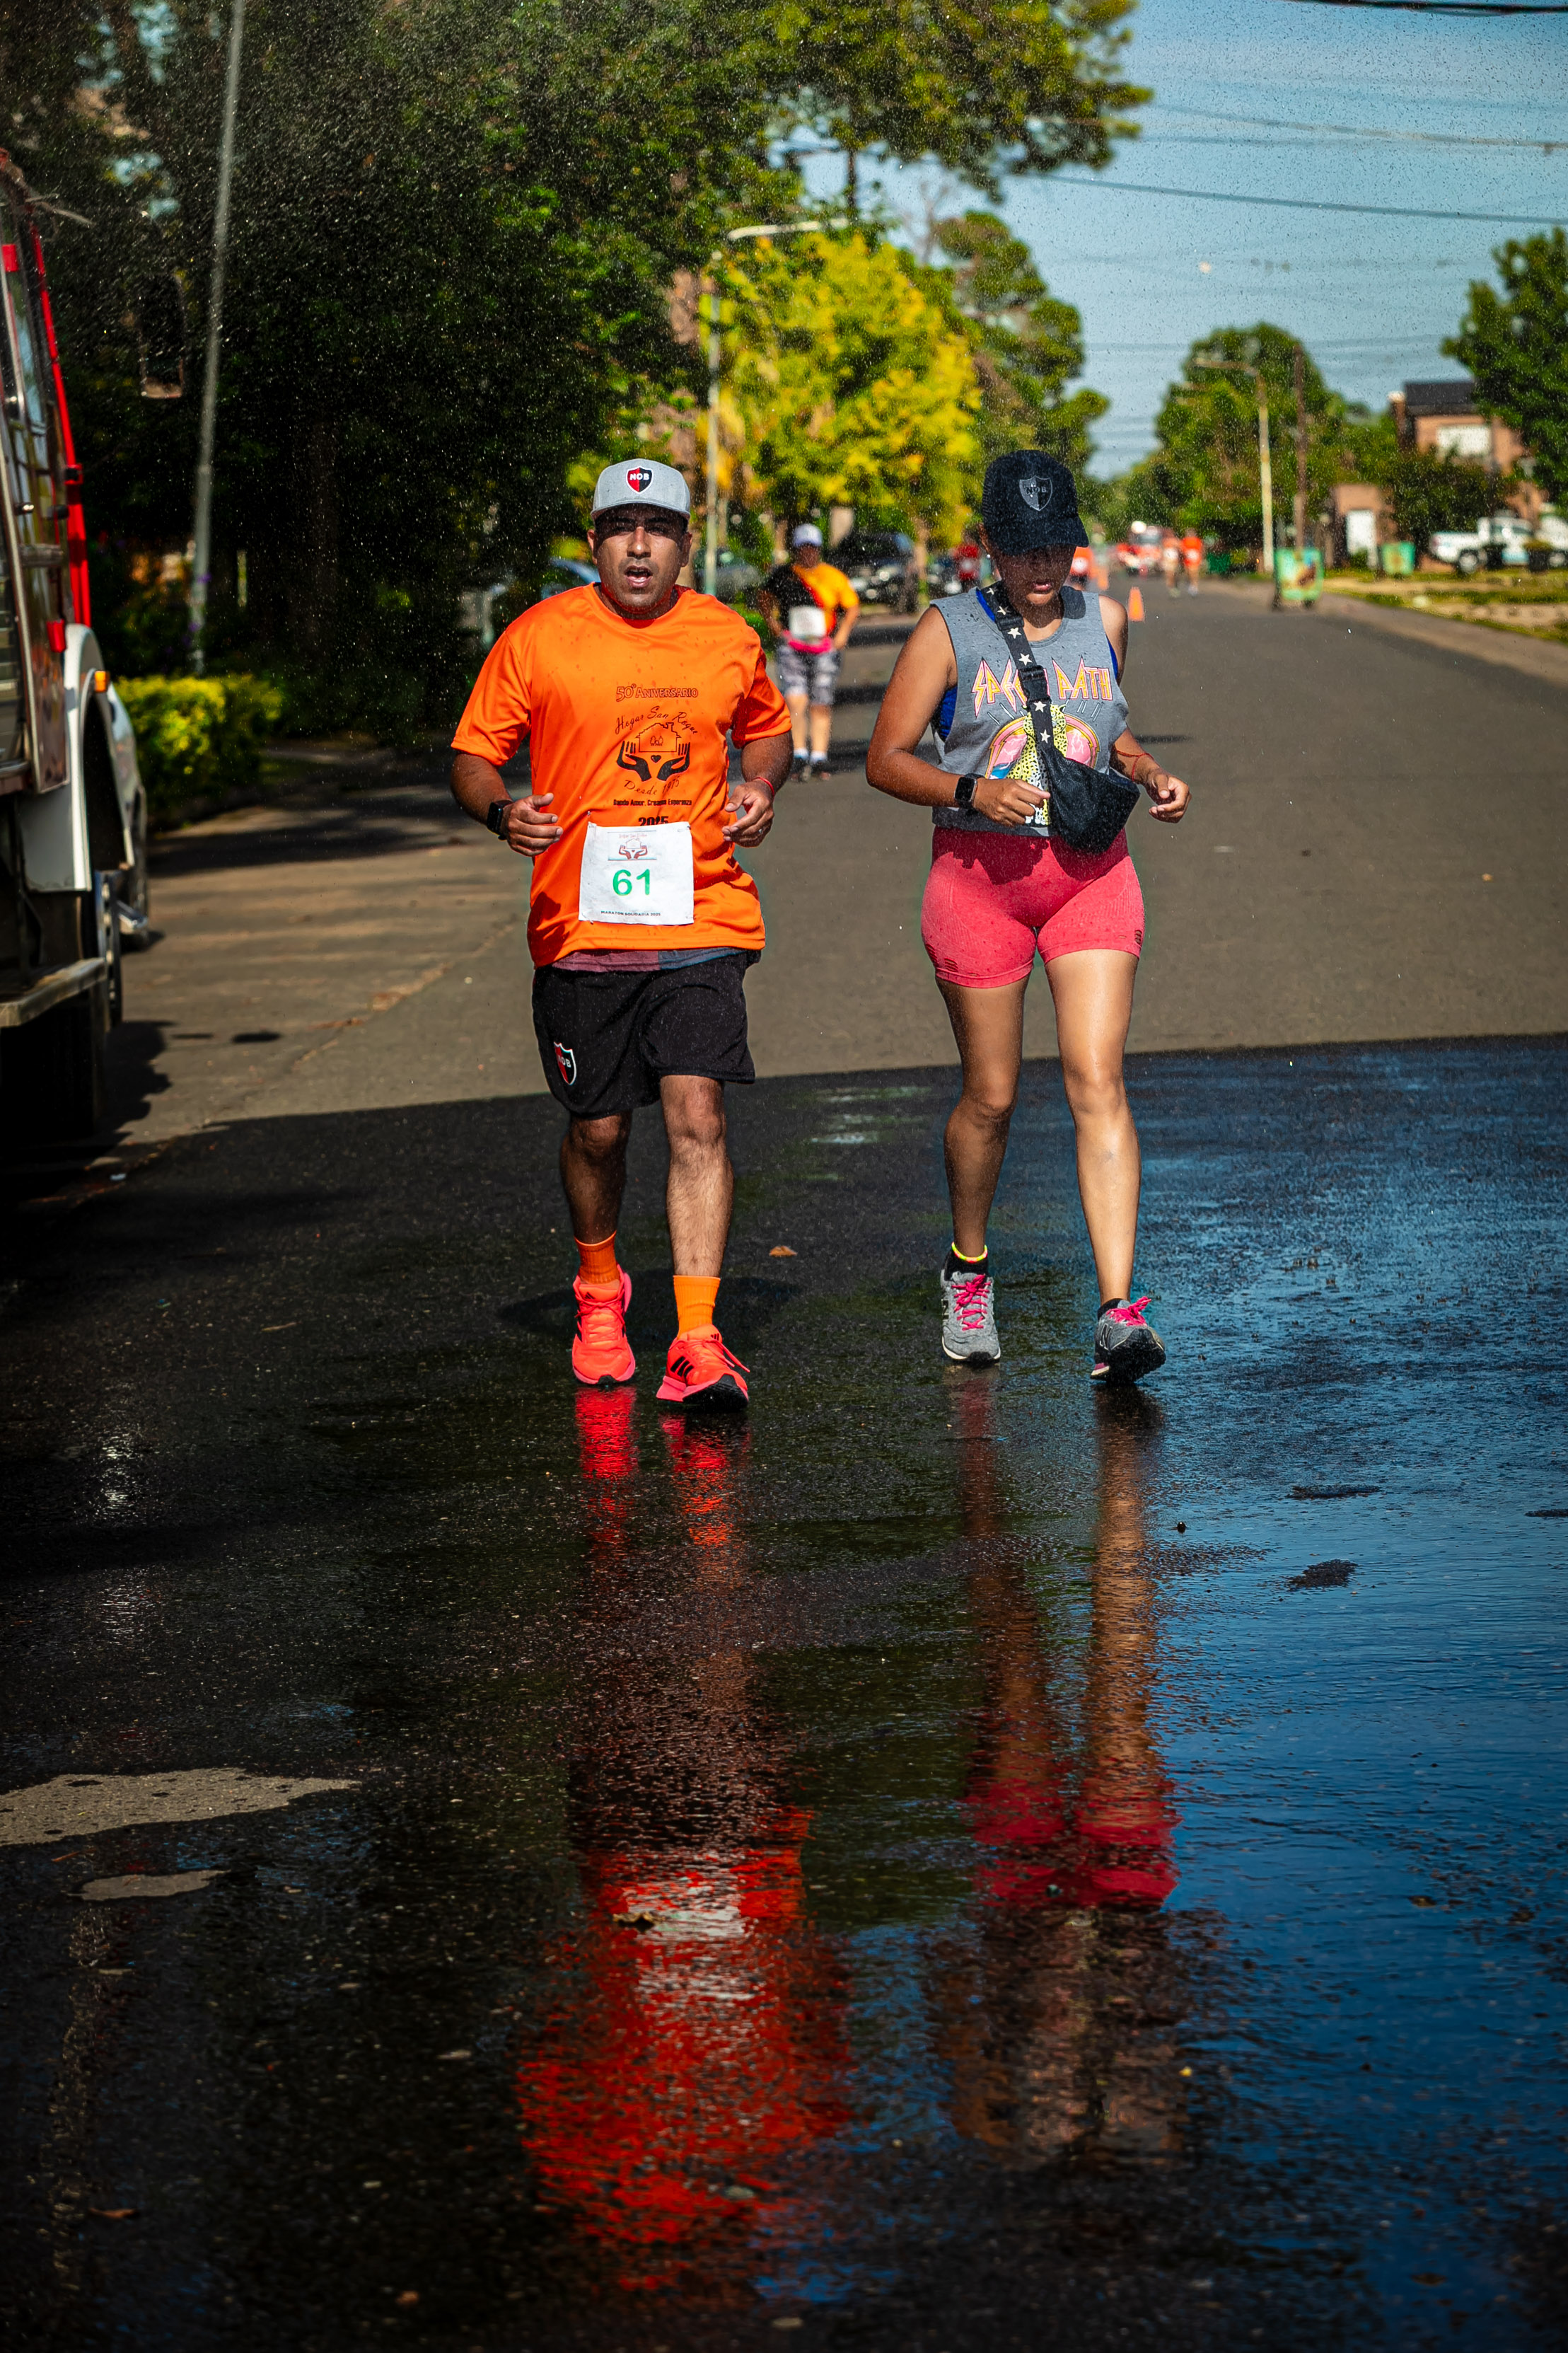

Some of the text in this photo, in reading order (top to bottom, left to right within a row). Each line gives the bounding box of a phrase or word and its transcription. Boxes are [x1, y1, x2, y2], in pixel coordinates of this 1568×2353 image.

[629, 473, 650, 481] NOB
[1025, 486, 1047, 495] NOB
[1051, 654, 1113, 701] PATH
[615, 705, 698, 735] Hogar San Roque
[624, 775, 680, 795] Desde 1975
[612, 868, 651, 896] 61
[557, 1055, 571, 1068] NOB
